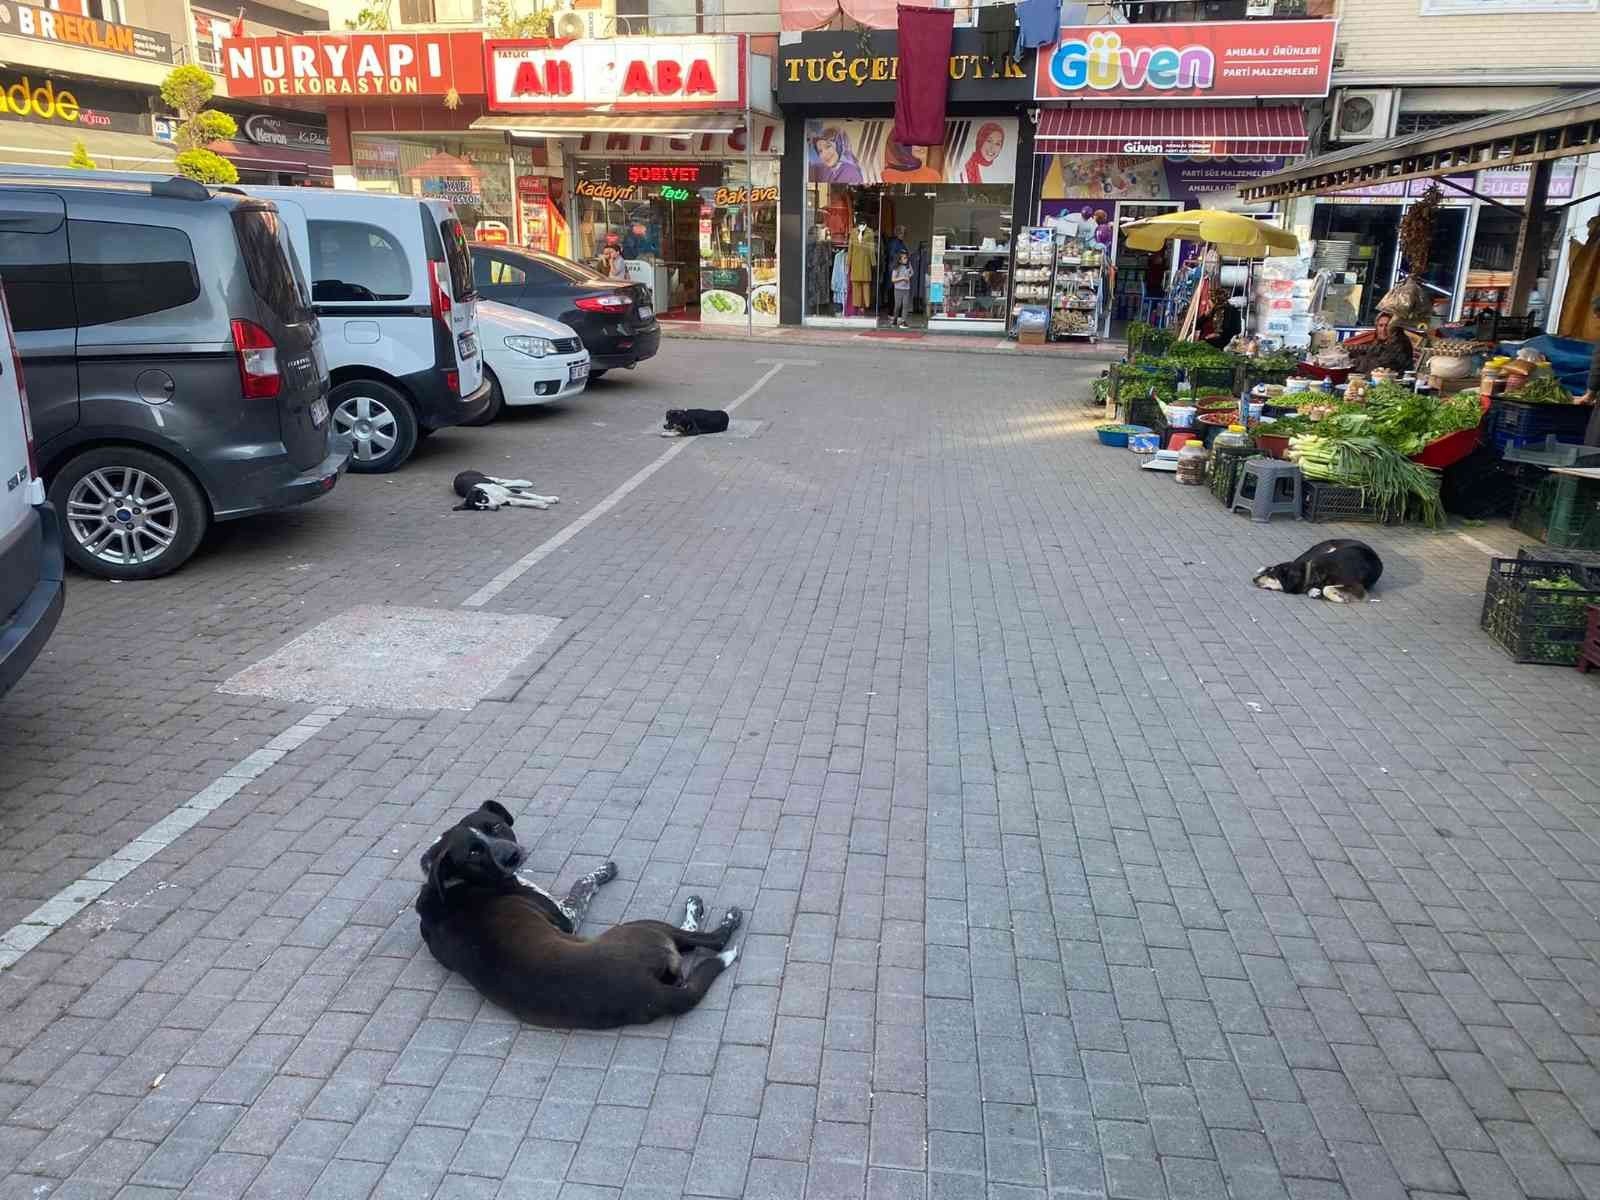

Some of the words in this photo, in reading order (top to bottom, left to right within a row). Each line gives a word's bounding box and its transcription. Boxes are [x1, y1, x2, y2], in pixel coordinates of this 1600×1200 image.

[55, 14, 134, 55] REKLAM
[1049, 32, 1215, 89] Güven
[1225, 47, 1269, 57] AMBALAJ
[1272, 45, 1321, 57] ÜRÜNLERİ
[1223, 66, 1250, 77] PARTİ
[1252, 65, 1318, 77] MALZEMELERİ
[263, 76, 418, 95] DEKORASYON
[1123, 142, 1163, 153] Güven
[576, 179, 637, 201] Kadayıf
[659, 185, 689, 201] Tatlı
[714, 185, 778, 206] Bakava
